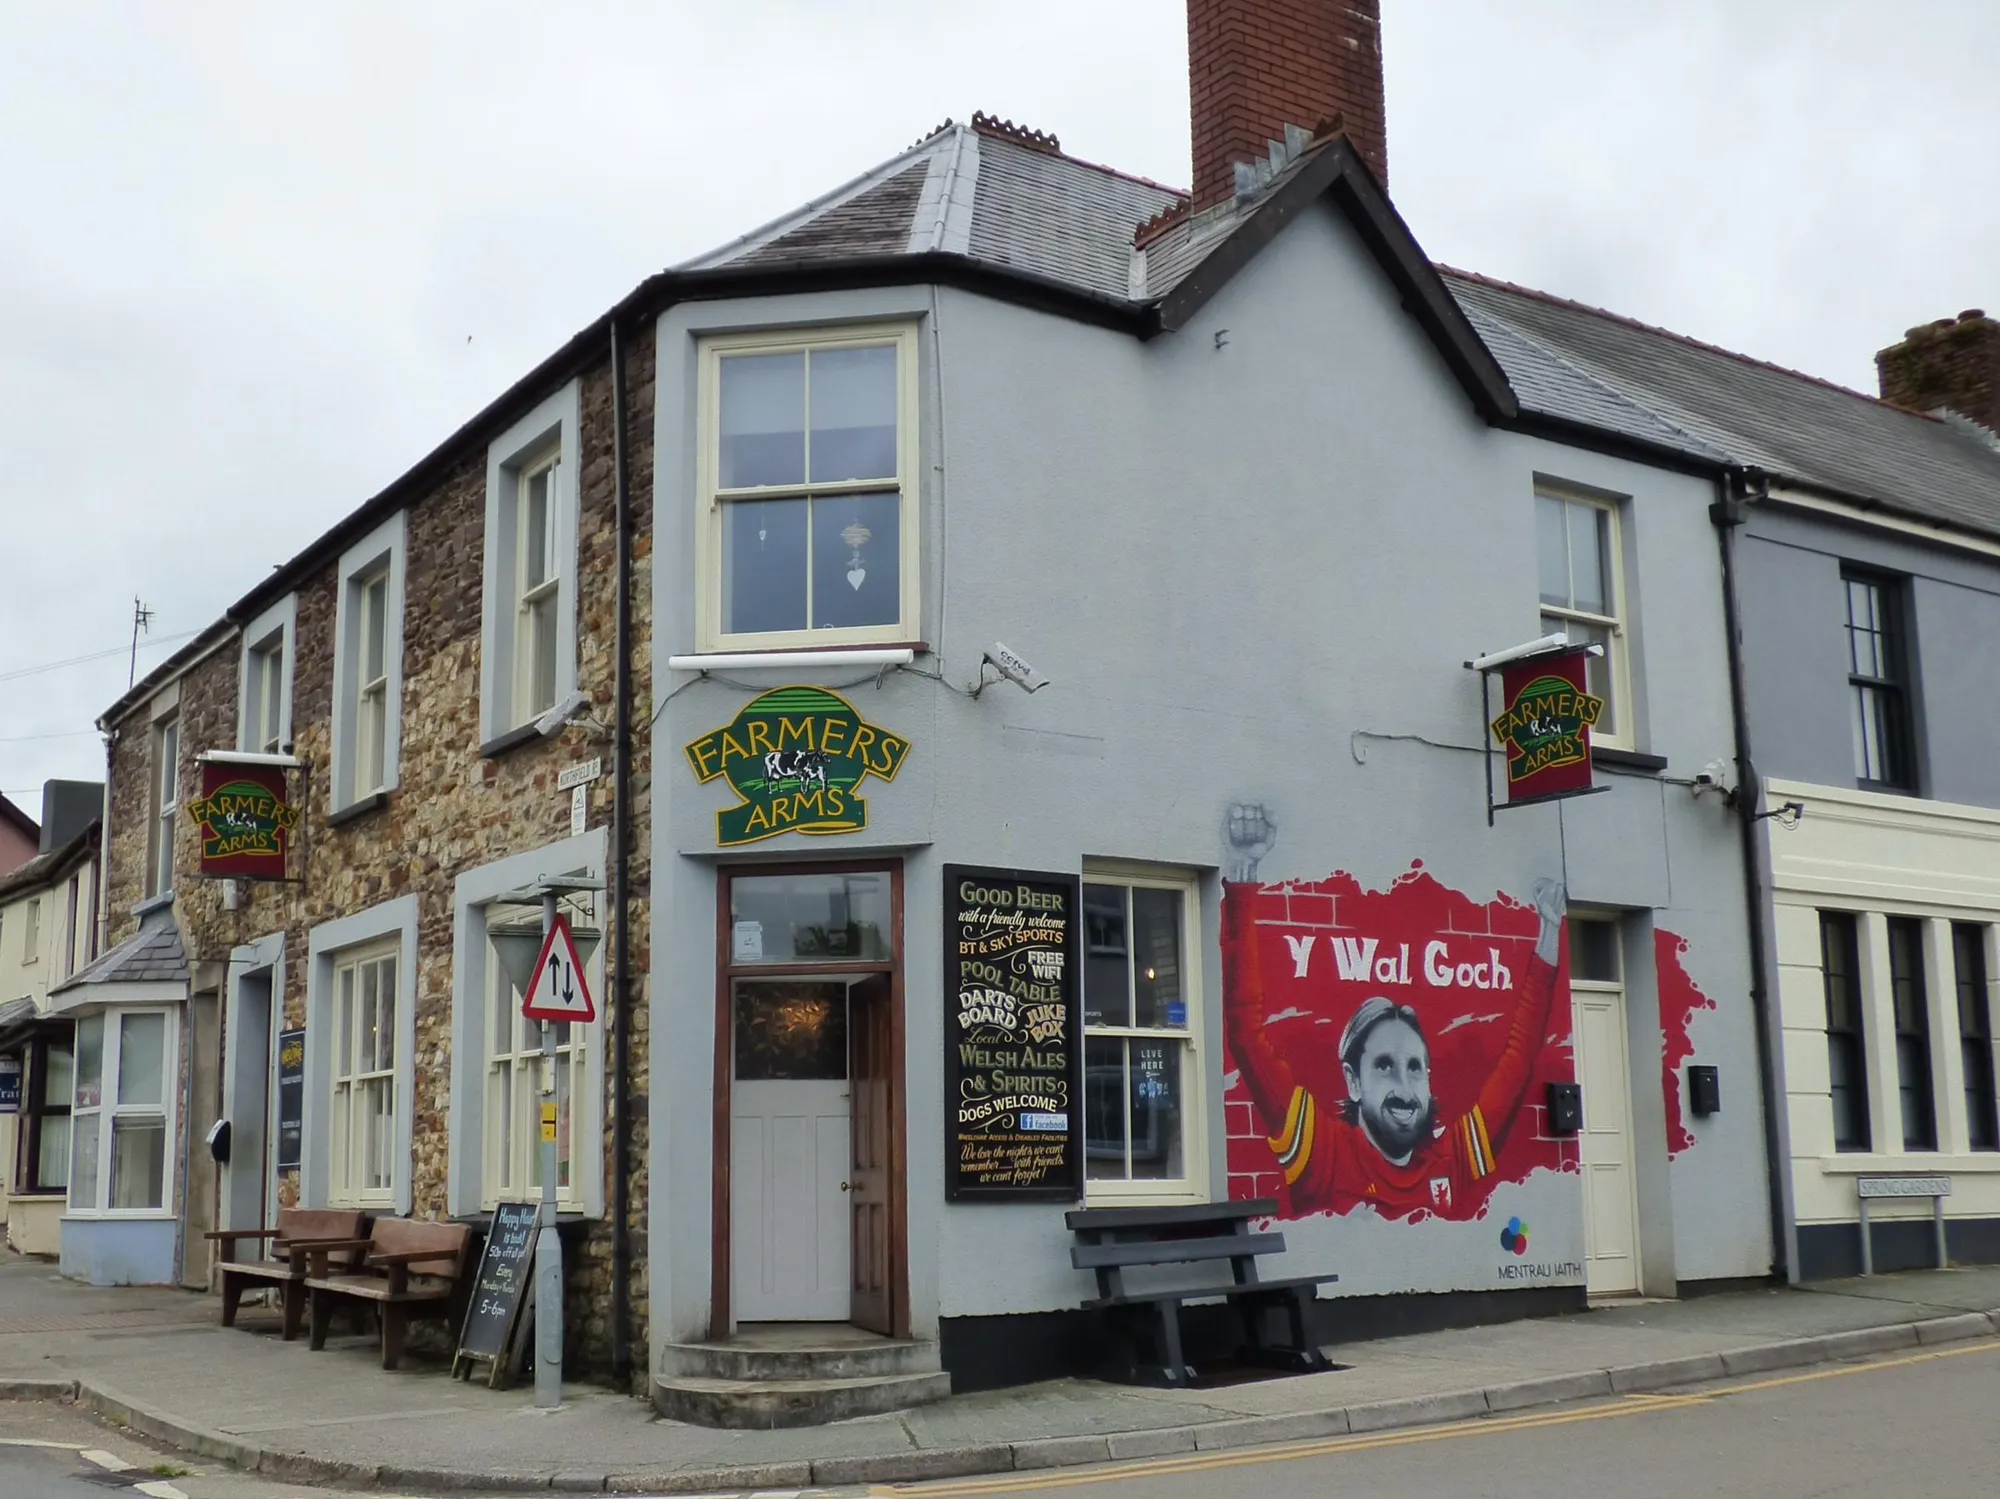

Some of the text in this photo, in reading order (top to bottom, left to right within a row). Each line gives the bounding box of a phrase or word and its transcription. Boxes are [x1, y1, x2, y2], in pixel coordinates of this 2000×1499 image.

[1494, 694, 1599, 740] FARMERS
[691, 716, 901, 777] FARMERS
[1524, 738, 1574, 773] ARMS
[191, 796, 297, 828] FARMERS
[744, 789, 845, 834] ARMS
[216, 832, 268, 853] ARMS
[958, 907, 1066, 933] with a friendly welcome
[959, 928, 1064, 955] BT & SKY SPORTS
[1028, 950, 1065, 967] FREE
[1283, 935, 1513, 991] Y Wal Goch
[960, 960, 1062, 1001] POOL TABLE
[1031, 964, 1062, 980] WIFI
[959, 989, 1017, 1012] DARTS
[957, 1006, 1017, 1030] BOARD
[1024, 1004, 1066, 1029] JUKE
[964, 1026, 1003, 1044] Local
[1030, 1020, 1066, 1043] BOX
[1141, 1049, 1162, 1058] LIVE
[1141, 1061, 1164, 1070] HERE
[974, 1075, 986, 1091] &
[959, 1095, 1058, 1123] DOGS WELCOME
[961, 1160, 999, 1172] remember
[1033, 1153, 1064, 1171] friends
[992, 1144, 1005, 1158] the
[1863, 1180, 1948, 1194] SPRING GARDENS
[499, 1207, 519, 1231] Happy
[496, 1263, 513, 1282] Every
[1498, 1262, 1582, 1279] MENTRAU IAITH
